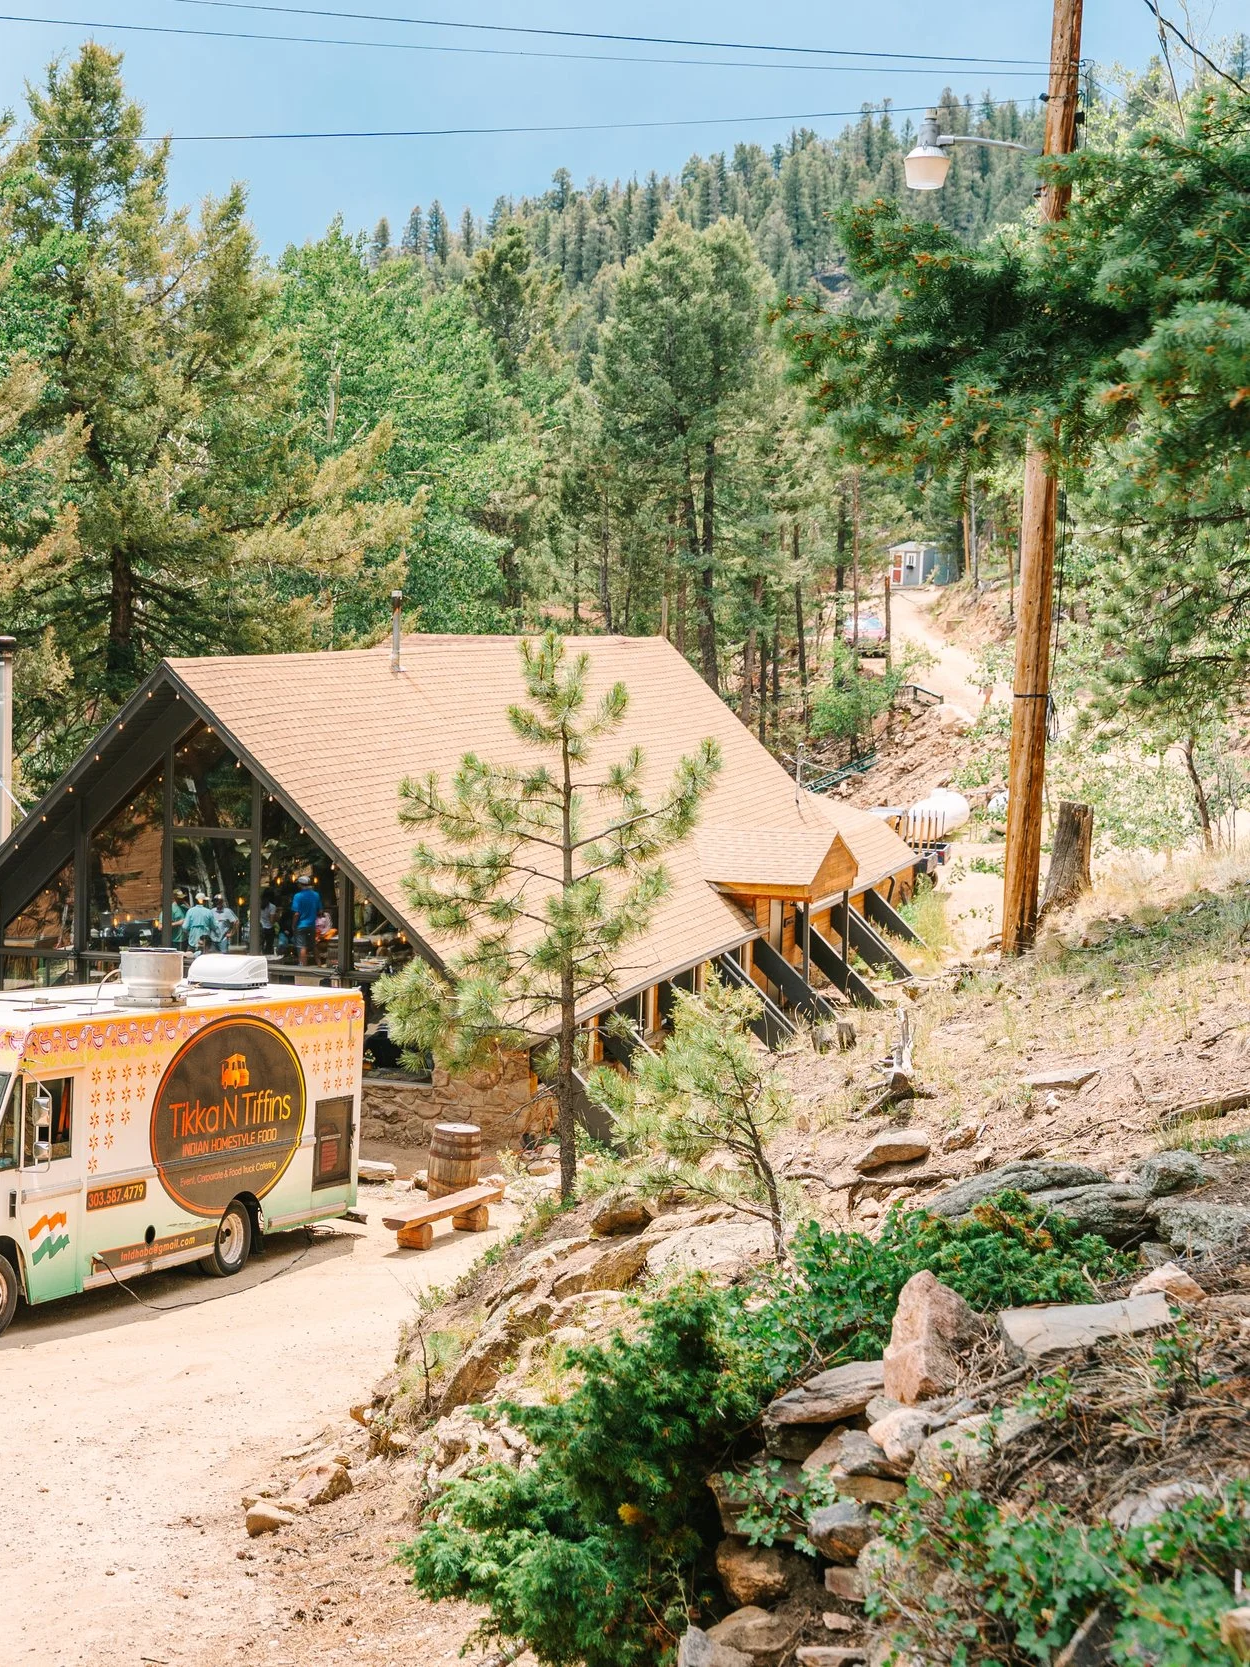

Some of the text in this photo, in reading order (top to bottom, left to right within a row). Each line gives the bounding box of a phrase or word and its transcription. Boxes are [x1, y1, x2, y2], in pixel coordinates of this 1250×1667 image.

[169, 1089, 291, 1138] Tikka N Tiffins
[182, 1128, 277, 1157] INDIAN HOMESTYLE FOOD
[228, 1167, 242, 1177] Food
[255, 1160, 277, 1172] Catering
[88, 1184, 144, 1208] 303.587.4779
